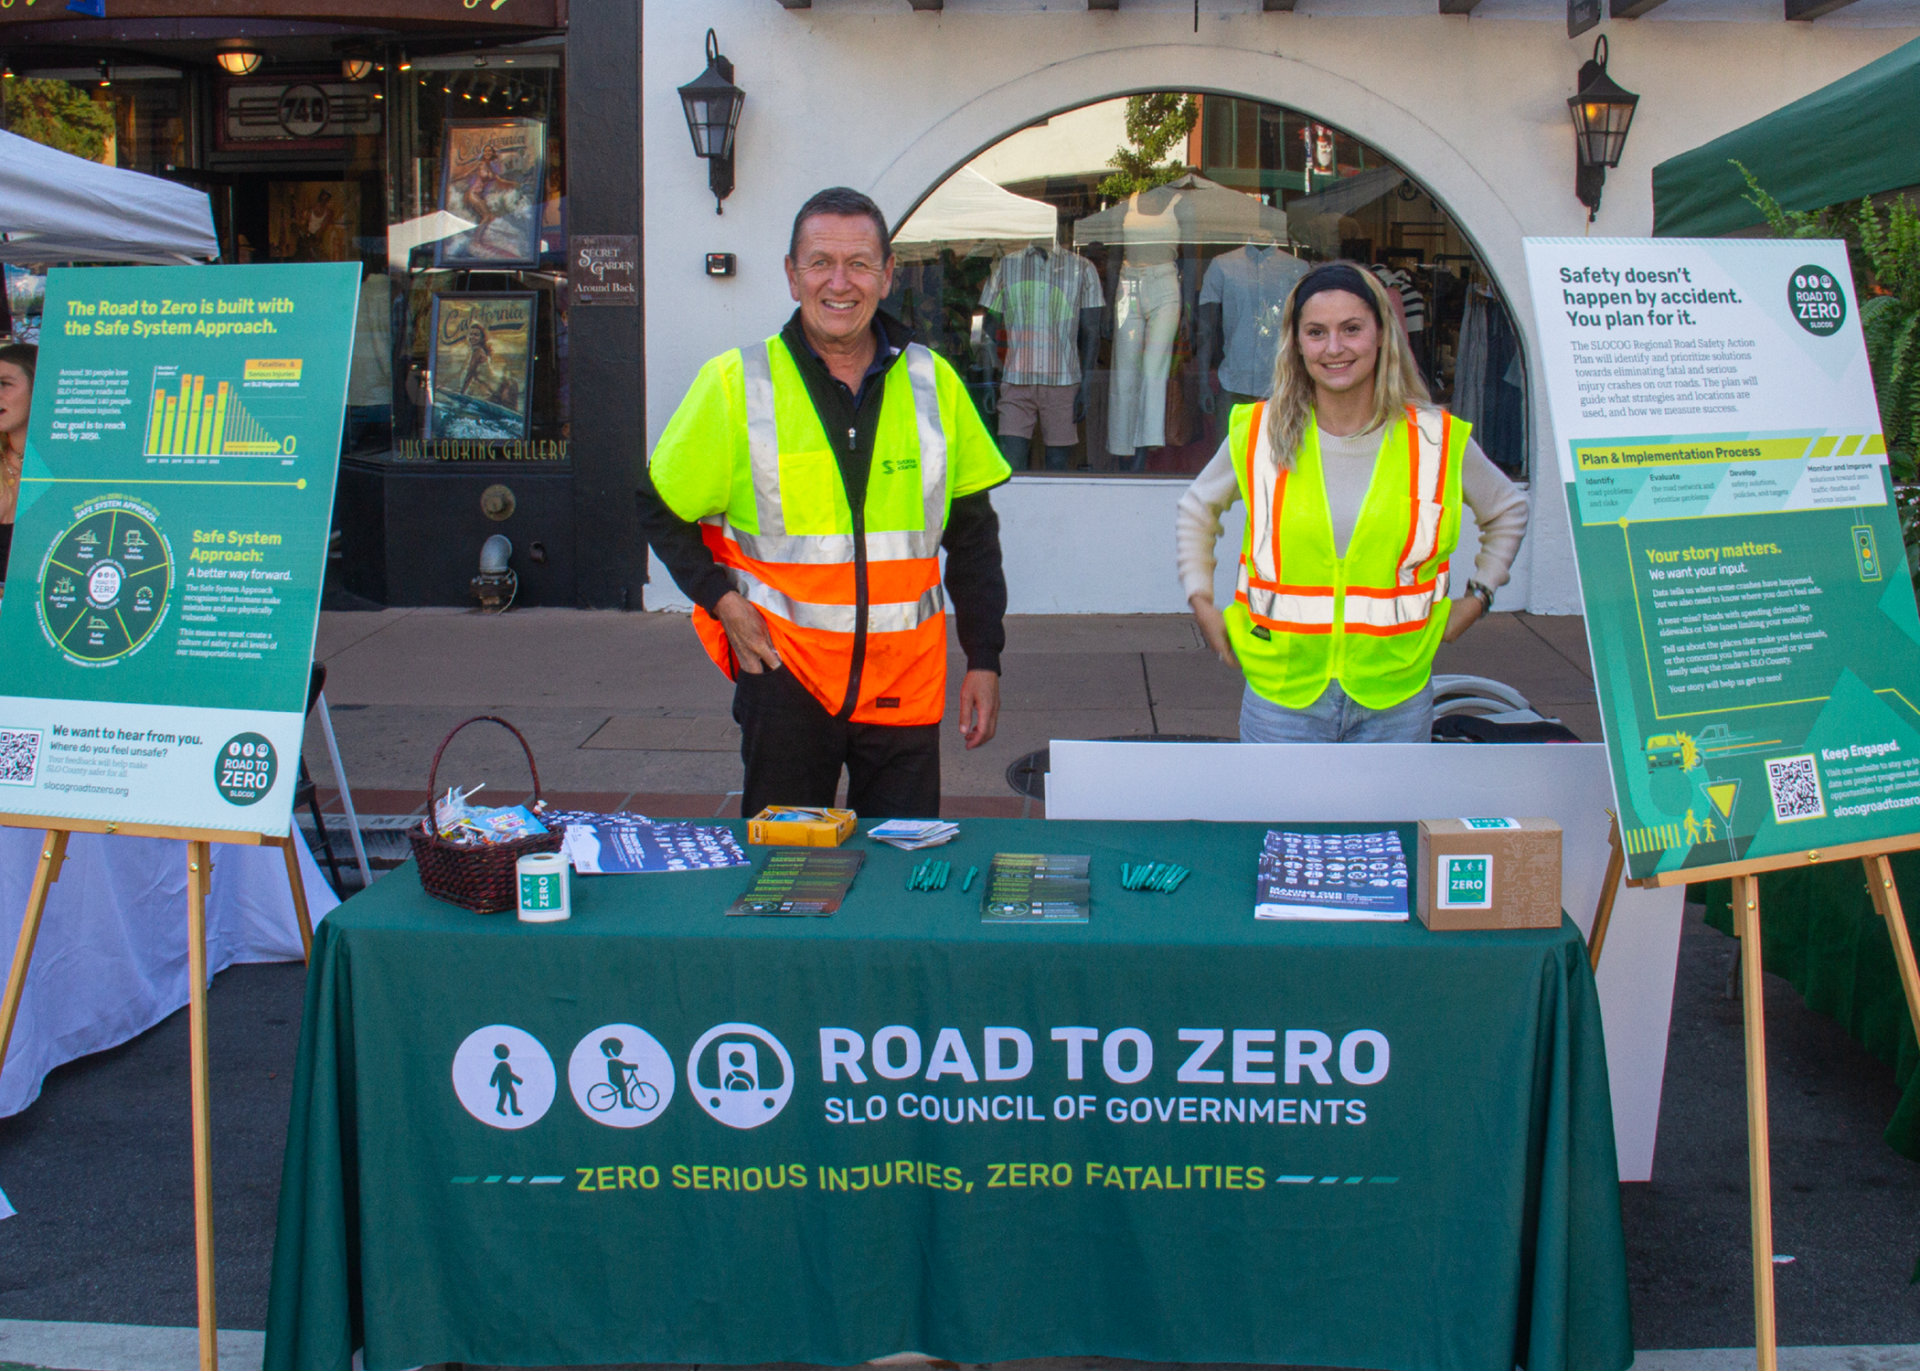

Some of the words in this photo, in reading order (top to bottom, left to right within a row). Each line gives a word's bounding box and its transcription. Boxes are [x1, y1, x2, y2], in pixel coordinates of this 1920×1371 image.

[1560, 266, 1620, 286] Safety
[1624, 267, 1692, 283] doesn't
[574, 283, 610, 292] Around
[612, 283, 635, 292] Back
[1563, 288, 1632, 308] happen
[1635, 288, 1656, 308] by
[1660, 288, 1742, 304] accident.
[1796, 292, 1823, 302] ROAD
[1823, 291, 1837, 301] TO
[68, 301, 95, 316] The
[100, 300, 139, 315] Road
[141, 300, 158, 315] to
[160, 300, 197, 315] Zero
[200, 298, 214, 314] is
[217, 298, 254, 314] built
[258, 298, 294, 313] with
[1797, 302, 1841, 318] ZERO
[64, 321, 91, 335] the
[94, 320, 129, 335] Safe
[132, 319, 191, 338] System
[194, 318, 277, 337] Approach.
[1566, 310, 1601, 326] You
[1605, 310, 1644, 330] plan
[1648, 310, 1674, 326] for
[1677, 310, 1696, 325] it.
[1570, 340, 1589, 350] The
[1591, 340, 1632, 350] SLOCOG
[1633, 339, 1672, 351] Regional
[1674, 339, 1696, 348] Road
[1698, 338, 1725, 350] Safety
[1727, 338, 1756, 347] Action
[1573, 354, 1594, 364] Plan
[1595, 354, 1613, 363] will
[1614, 353, 1649, 365] identify
[1652, 352, 1668, 362] and
[1671, 352, 1710, 364] prioritize
[1712, 351, 1752, 360] solutions
[1575, 367, 1612, 377] towards
[1614, 366, 1665, 378] eliminating
[1666, 365, 1686, 375] fatal
[1688, 365, 1704, 374] and
[1706, 364, 1737, 374] serious
[1577, 381, 1605, 393] injury
[1607, 380, 1642, 390] crashes
[1643, 381, 1655, 389] on
[1674, 378, 1701, 388] roads.
[1702, 377, 1719, 387] The
[1721, 377, 1741, 389] plan
[1742, 376, 1758, 386] will
[1580, 394, 1606, 407] guide
[1608, 394, 1630, 403] what
[1632, 392, 1675, 404] strategies
[1677, 391, 1694, 401] and
[1695, 390, 1735, 400] locations
[1737, 391, 1750, 399] are
[1582, 408, 1607, 418] used,
[1609, 407, 1626, 417] and
[1628, 406, 1647, 416] how
[1664, 406, 1701, 415] measure
[1703, 405, 1738, 413] success.
[52, 421, 68, 429] Our
[68, 421, 86, 431] goal
[86, 421, 93, 429] is
[94, 421, 103, 429] to
[104, 421, 126, 429] reach
[69, 431, 80, 442] by
[399, 439, 429, 460] JUST
[433, 439, 496, 460] LOOKING
[502, 439, 567, 460] GALLERY
[1582, 454, 1609, 465] Plan
[1611, 452, 1620, 464] &
[1622, 448, 1714, 465] Implementation
[1715, 447, 1761, 458] Process
[1586, 477, 1614, 485] Identify
[1649, 473, 1680, 481] Evaluate
[1729, 469, 1756, 477] Develop
[75, 505, 94, 519] SAFE
[94, 500, 122, 510] SYSTEM
[123, 501, 157, 523] APPROACH
[192, 530, 225, 543] Safe
[227, 531, 282, 547] System
[190, 547, 264, 563] Approach:
[1645, 549, 1680, 563] Your
[1682, 546, 1719, 562] story
[1722, 542, 1782, 558] matters.
[187, 567, 196, 578] A
[197, 568, 228, 579] better
[229, 570, 250, 581] way
[251, 568, 292, 580] forward.
[1649, 569, 1665, 580] We
[1666, 566, 1693, 578] want
[1694, 566, 1717, 579] your
[1718, 562, 1748, 576] input.
[94, 585, 116, 594] ZERO
[53, 724, 69, 736] We
[71, 727, 100, 738] want
[102, 727, 115, 739] to
[117, 728, 145, 741] hear
[147, 730, 175, 743] from
[178, 734, 203, 746] you.
[50, 742, 78, 751] Where
[80, 742, 91, 752] do
[93, 745, 109, 755] you
[111, 745, 129, 755] feel
[130, 748, 168, 757] unsafe?
[1822, 748, 1849, 761] Keep
[1850, 739, 1900, 758] Engaged.
[224, 758, 254, 770] ROAD
[256, 760, 269, 771] TO
[221, 770, 268, 789] ZERO
[44, 782, 129, 797] slocogroadtozero.org
[538, 877, 549, 907] ZERO
[1451, 880, 1483, 890] ZERO
[819, 1025, 1033, 1084] ROAD
[1051, 1026, 1154, 1084] TO
[1177, 1028, 1391, 1086] ZERO
[825, 1096, 887, 1123] SLO
[897, 1092, 1045, 1124] COUNCIL
[1052, 1095, 1096, 1120] OF
[1105, 1097, 1368, 1125] GOVERNMENTS
[576, 1164, 660, 1191] ZERO
[671, 1163, 808, 1191] SERIOUS
[818, 1160, 975, 1194] INJURIES,
[987, 1162, 1074, 1188] ZERO
[1086, 1162, 1266, 1191] FATALITIES
